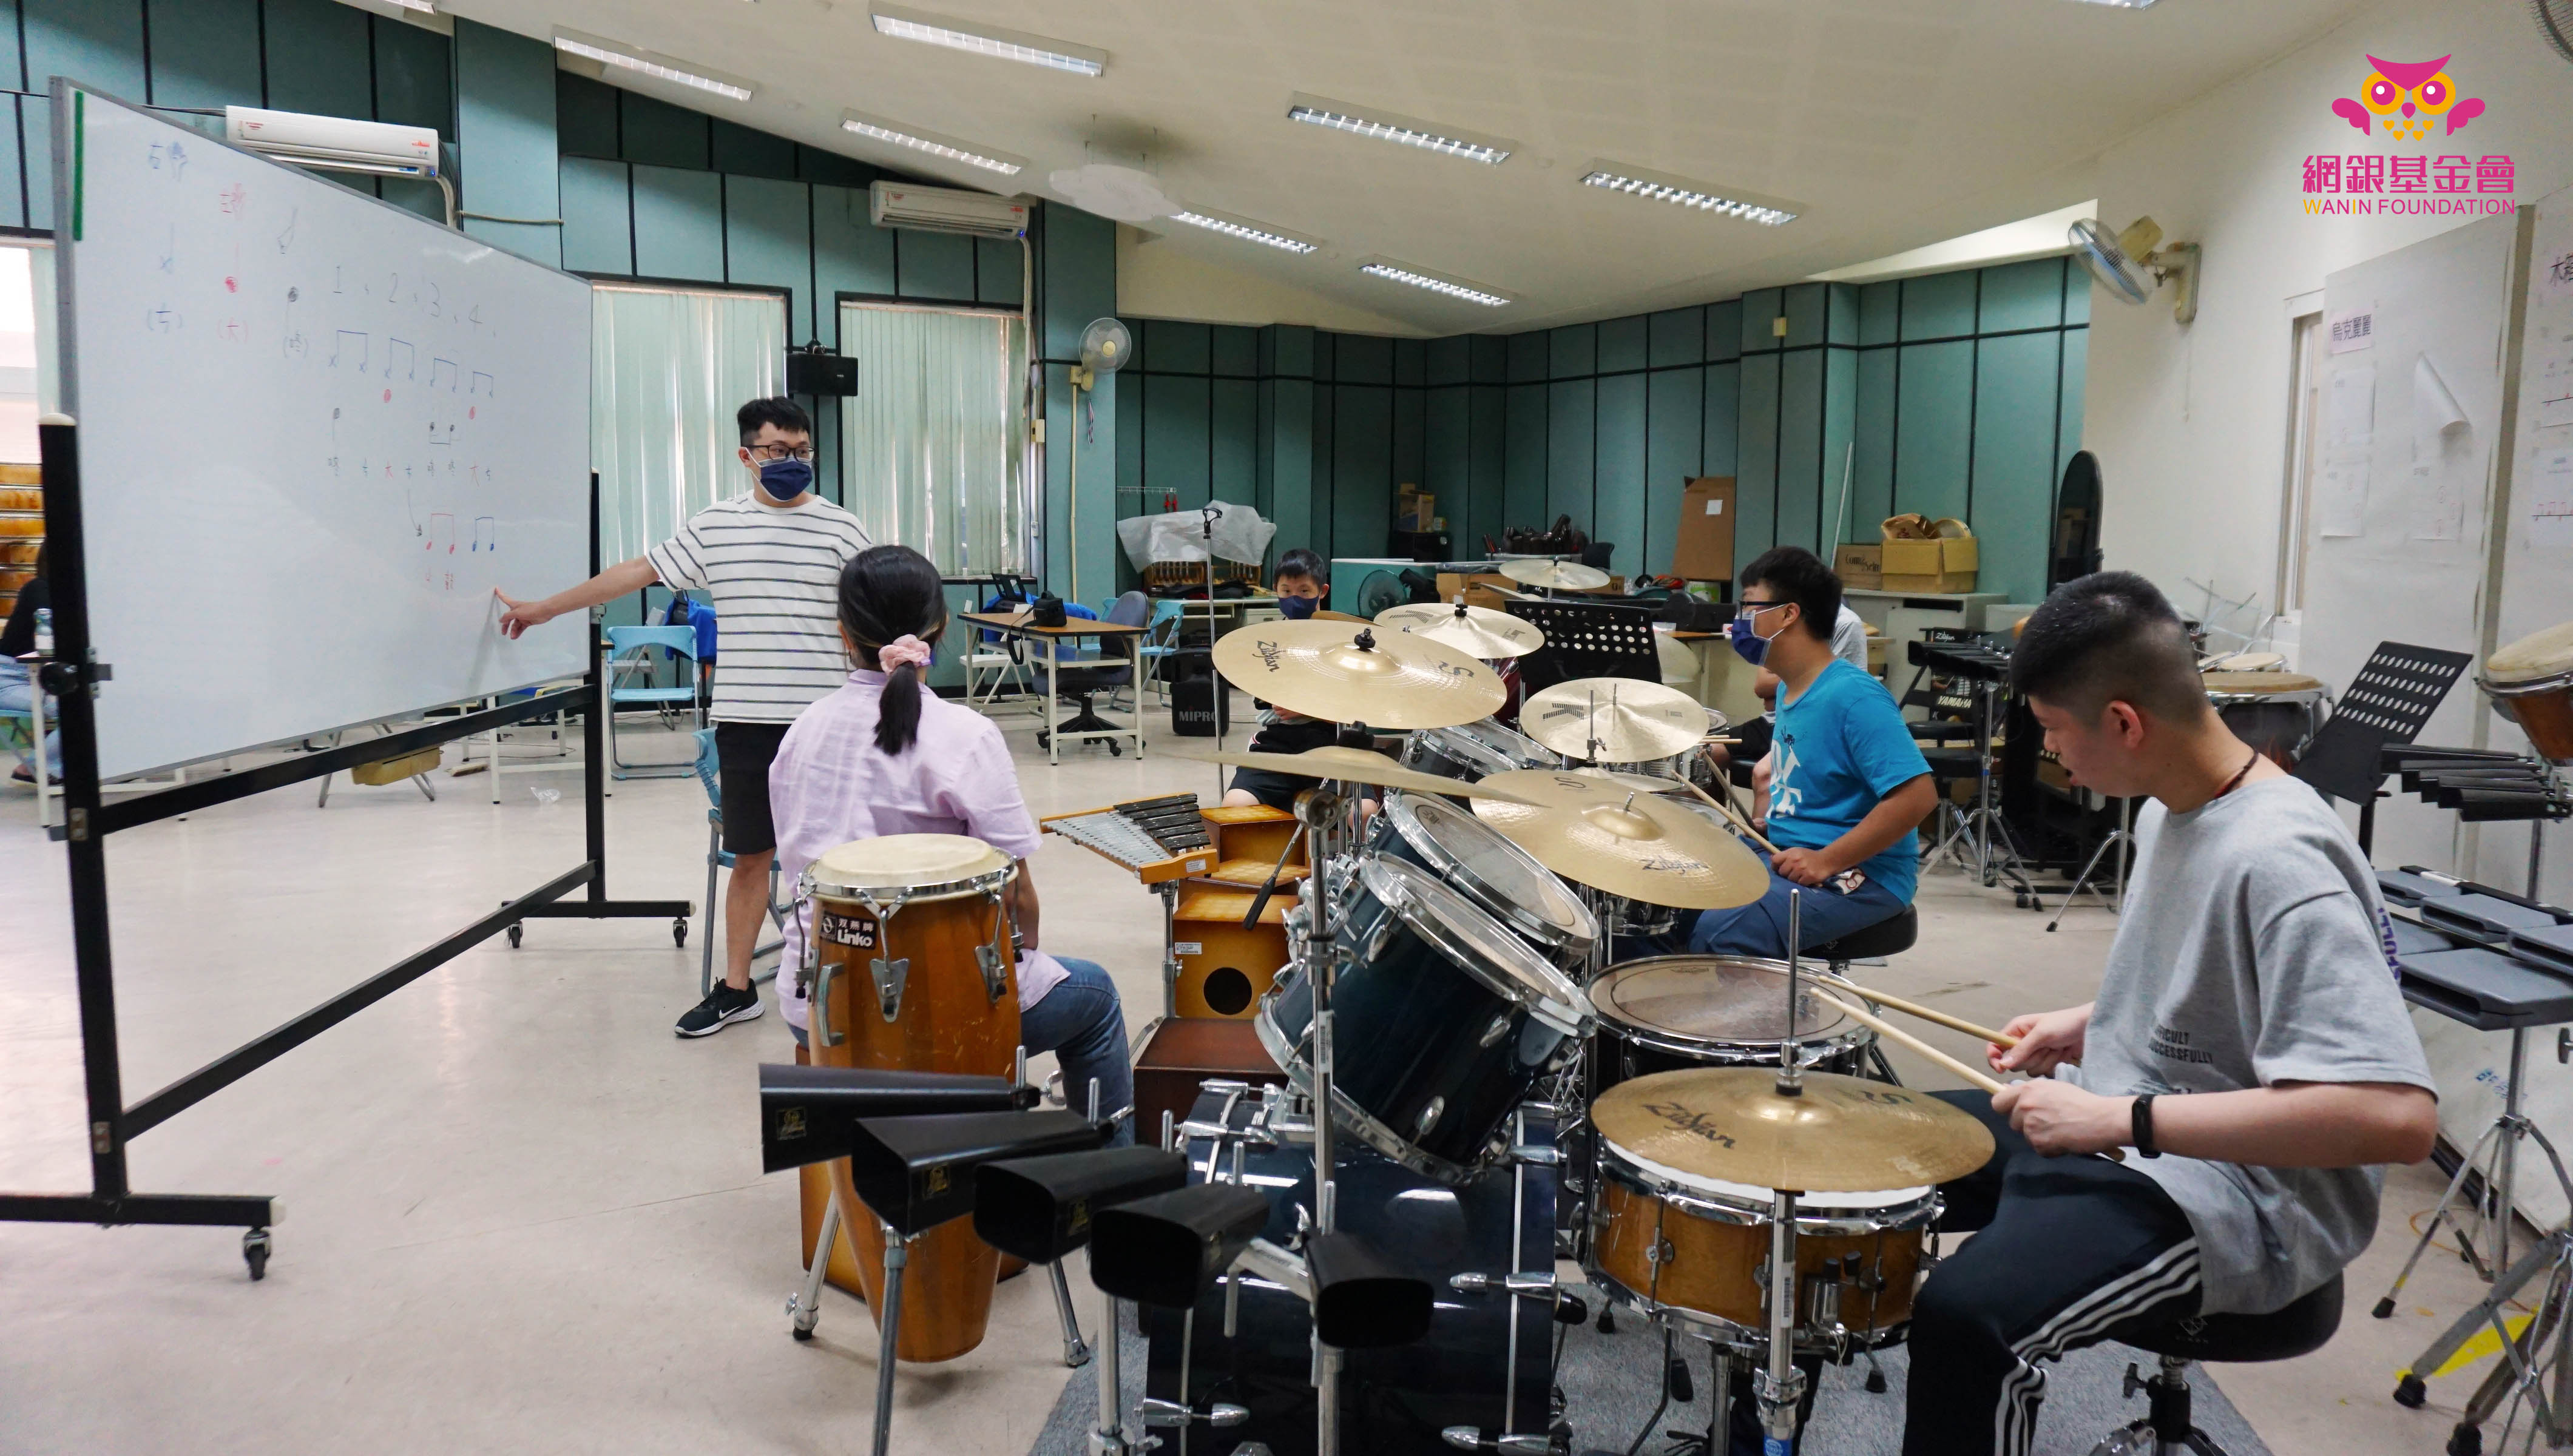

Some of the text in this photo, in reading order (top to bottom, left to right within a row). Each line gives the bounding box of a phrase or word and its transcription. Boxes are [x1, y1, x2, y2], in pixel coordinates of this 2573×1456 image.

[1252, 640, 1286, 673] Zildjian
[1937, 695, 1972, 709] YAMAHA
[837, 928, 874, 947] Linko
